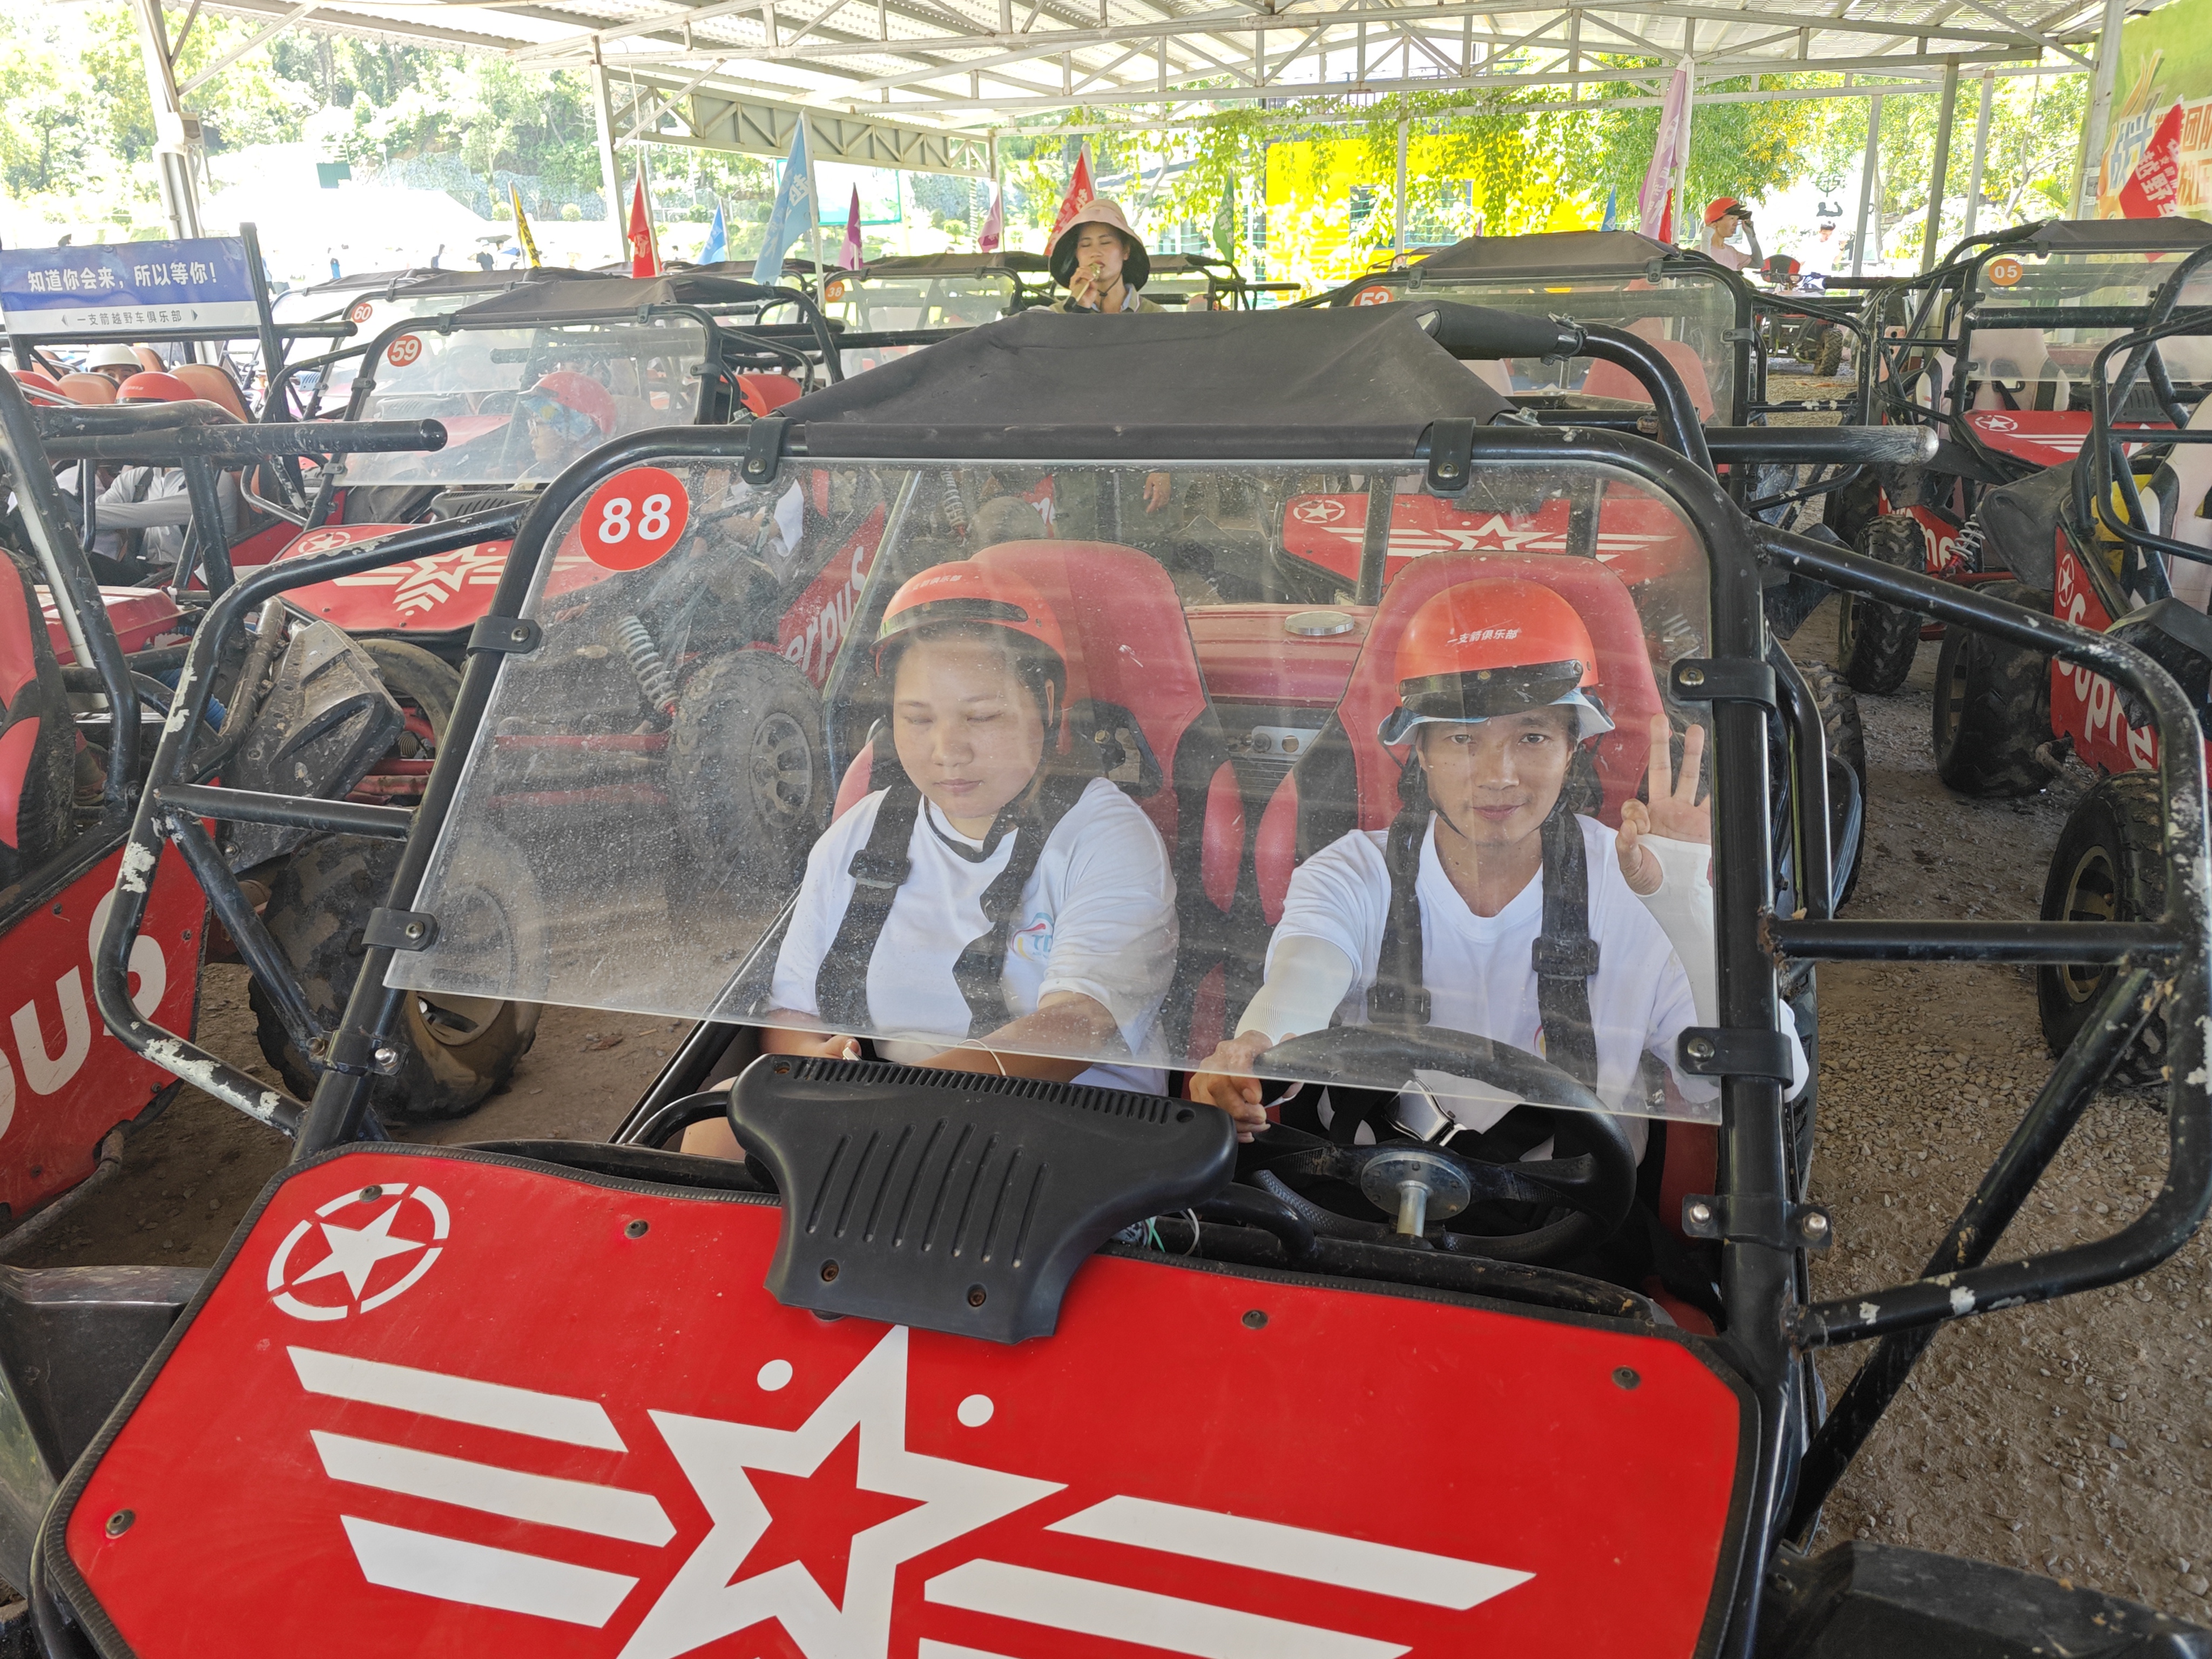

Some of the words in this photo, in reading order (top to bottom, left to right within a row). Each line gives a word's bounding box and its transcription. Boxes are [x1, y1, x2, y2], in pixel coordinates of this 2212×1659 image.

[1994, 265, 2018, 279] 05
[827, 286, 843, 298] 38
[77, 309, 183, 326] 一支箭越野车俱乐部
[354, 305, 372, 321] 60
[390, 339, 419, 362] 59
[598, 493, 672, 544] 88
[1447, 629, 1519, 645] 一支箭俱乐部
